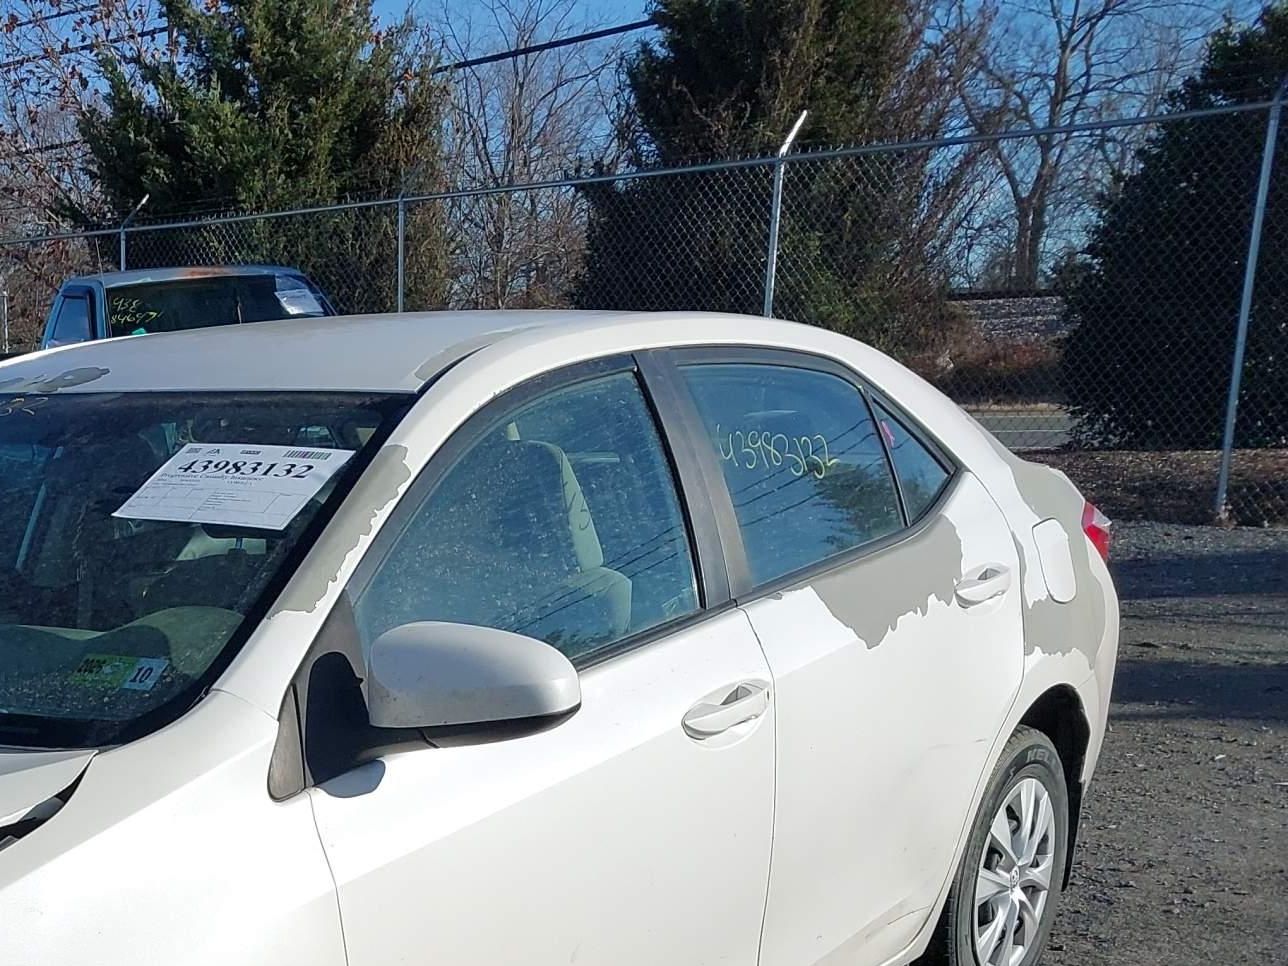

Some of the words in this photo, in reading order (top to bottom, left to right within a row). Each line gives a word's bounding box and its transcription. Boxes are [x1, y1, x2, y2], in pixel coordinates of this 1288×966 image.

[716, 423, 841, 479] 43983132
[178, 458, 315, 479] 43983132
[129, 666, 154, 684] 10
